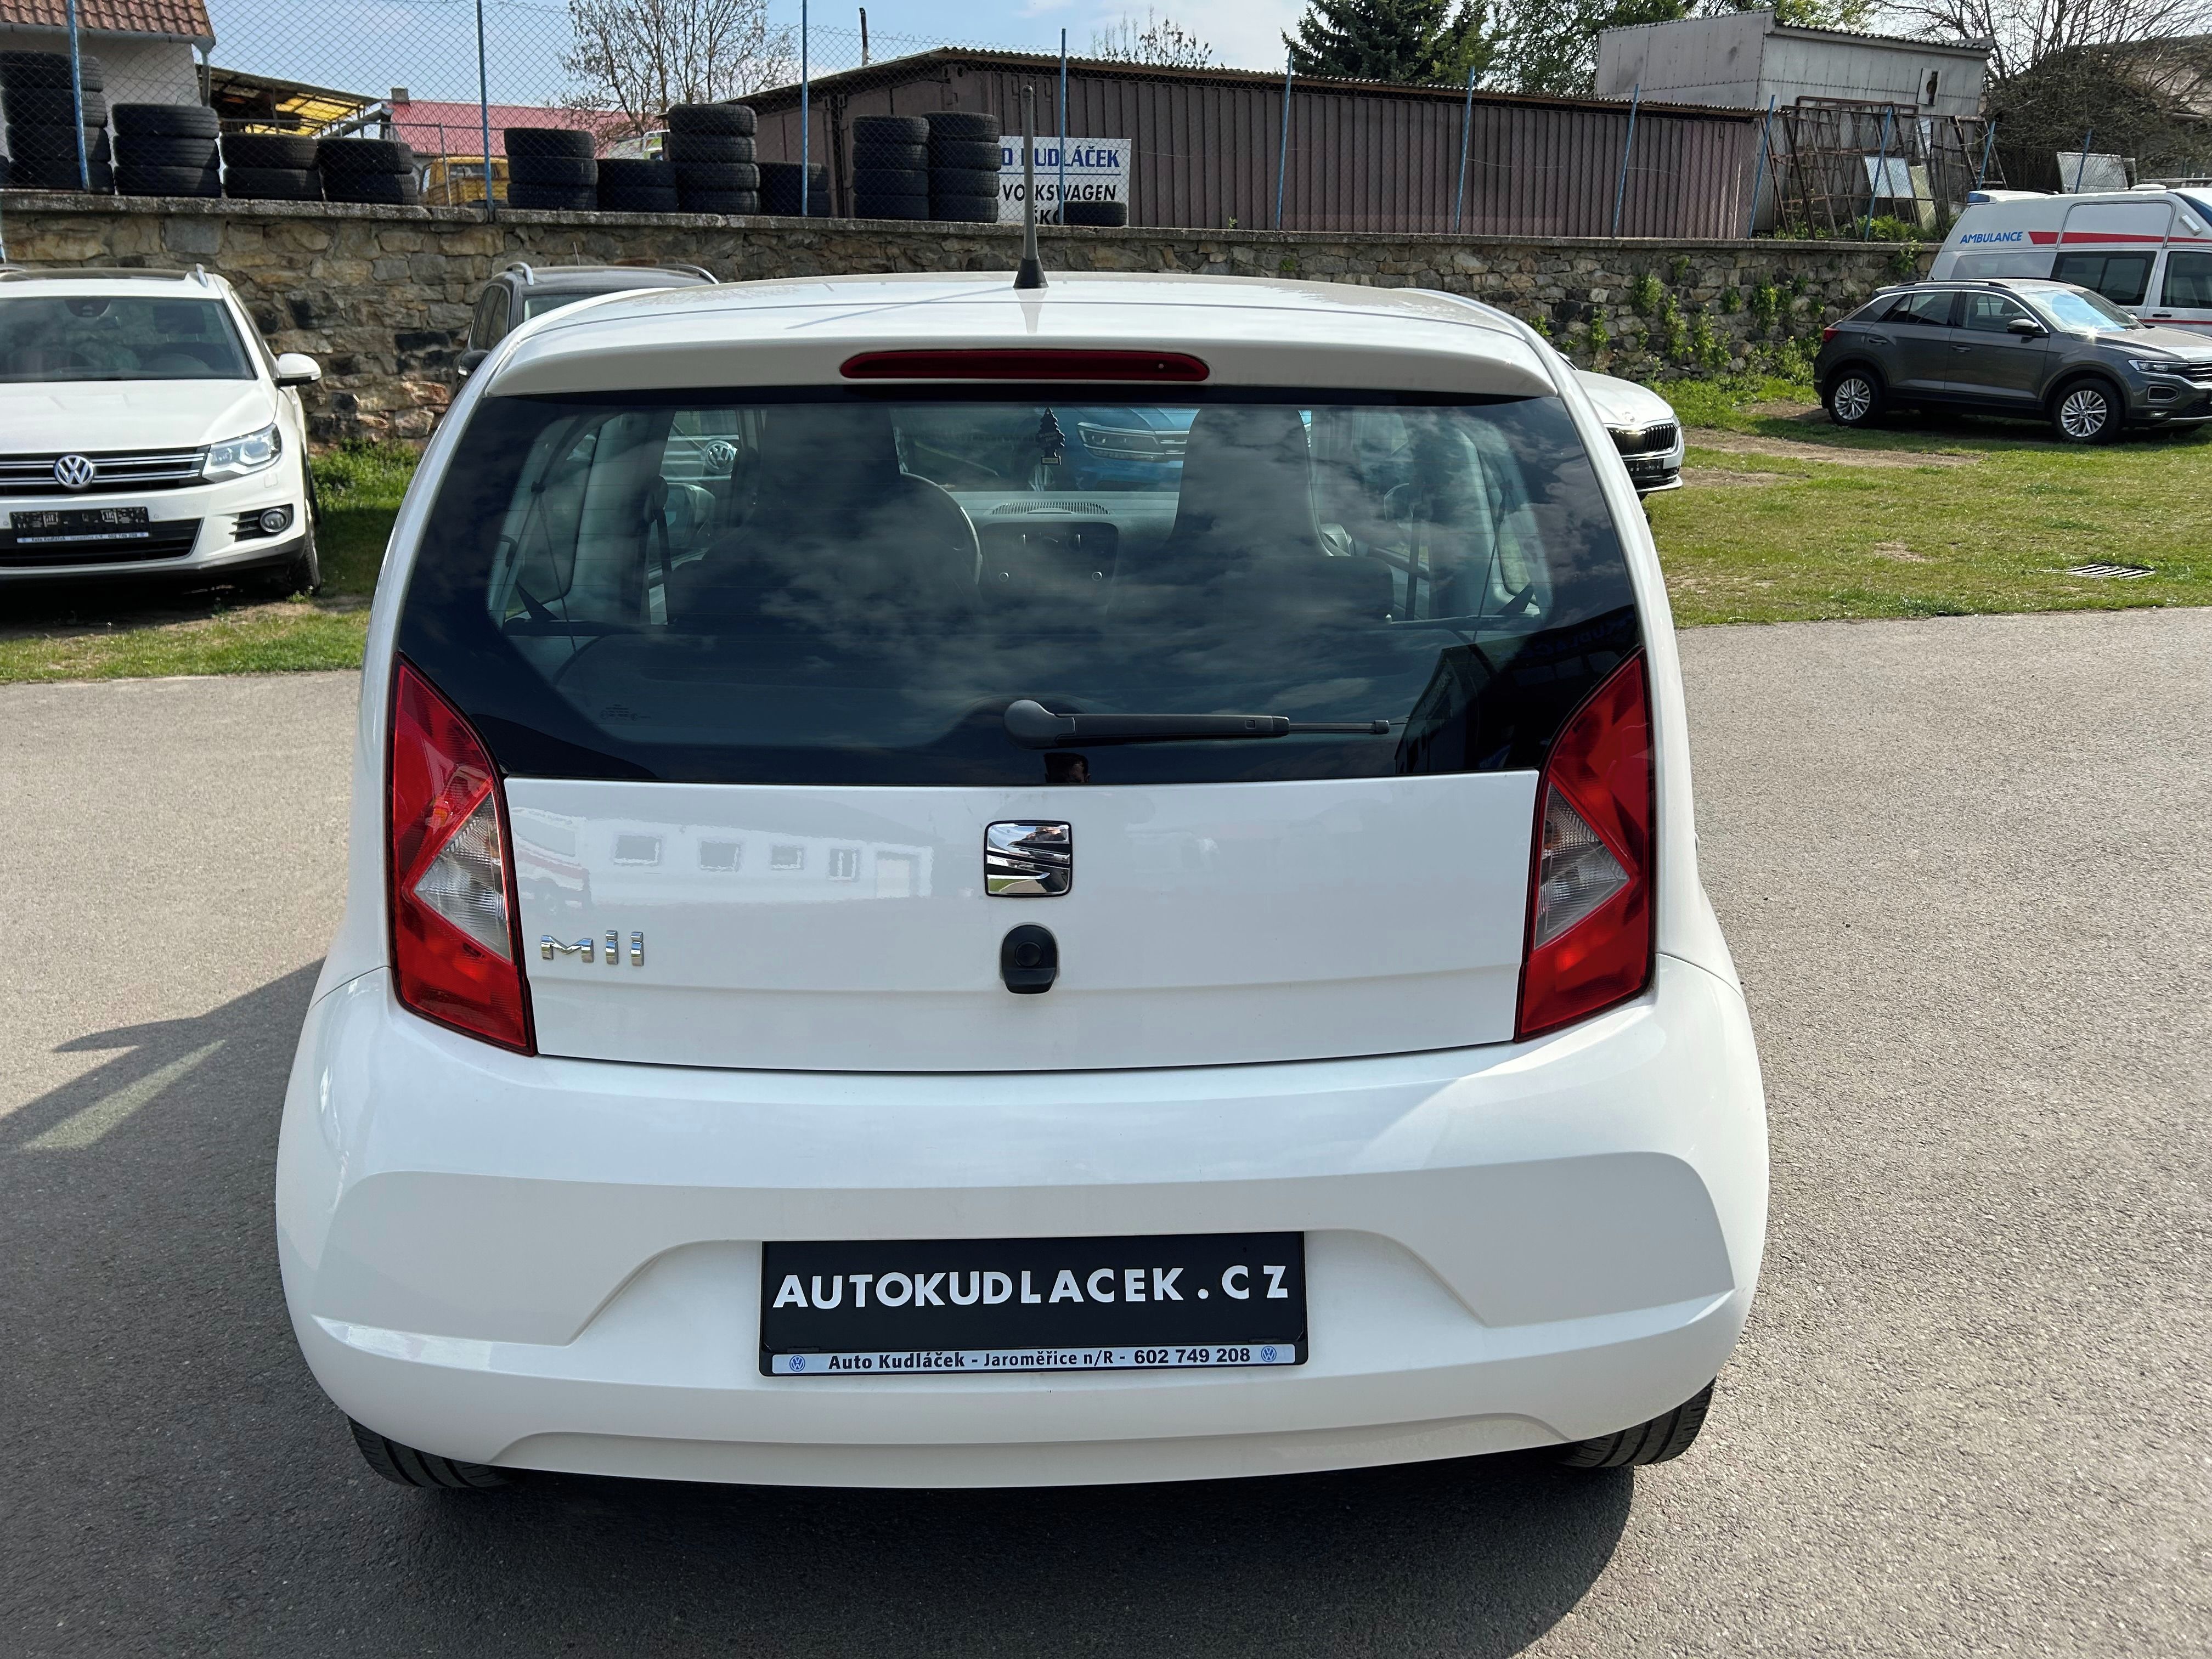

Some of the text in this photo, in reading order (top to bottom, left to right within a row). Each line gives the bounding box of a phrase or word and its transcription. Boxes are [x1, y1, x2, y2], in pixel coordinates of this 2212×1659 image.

[1021, 145, 1120, 167] UDÁČEK
[1002, 184, 1117, 201] VOKSWAGEN
[1960, 232, 2023, 244] AMBULANCE
[541, 930, 644, 966] Mii
[828, 1355, 872, 1369] Auto
[879, 1352, 965, 1369] Kudláček
[984, 1348, 1077, 1367] Jaroměřice
[1083, 1350, 1114, 1367] n/R
[1133, 1350, 1169, 1364] 602
[1175, 1348, 1210, 1363] 749
[1216, 1347, 1251, 1362] 208
